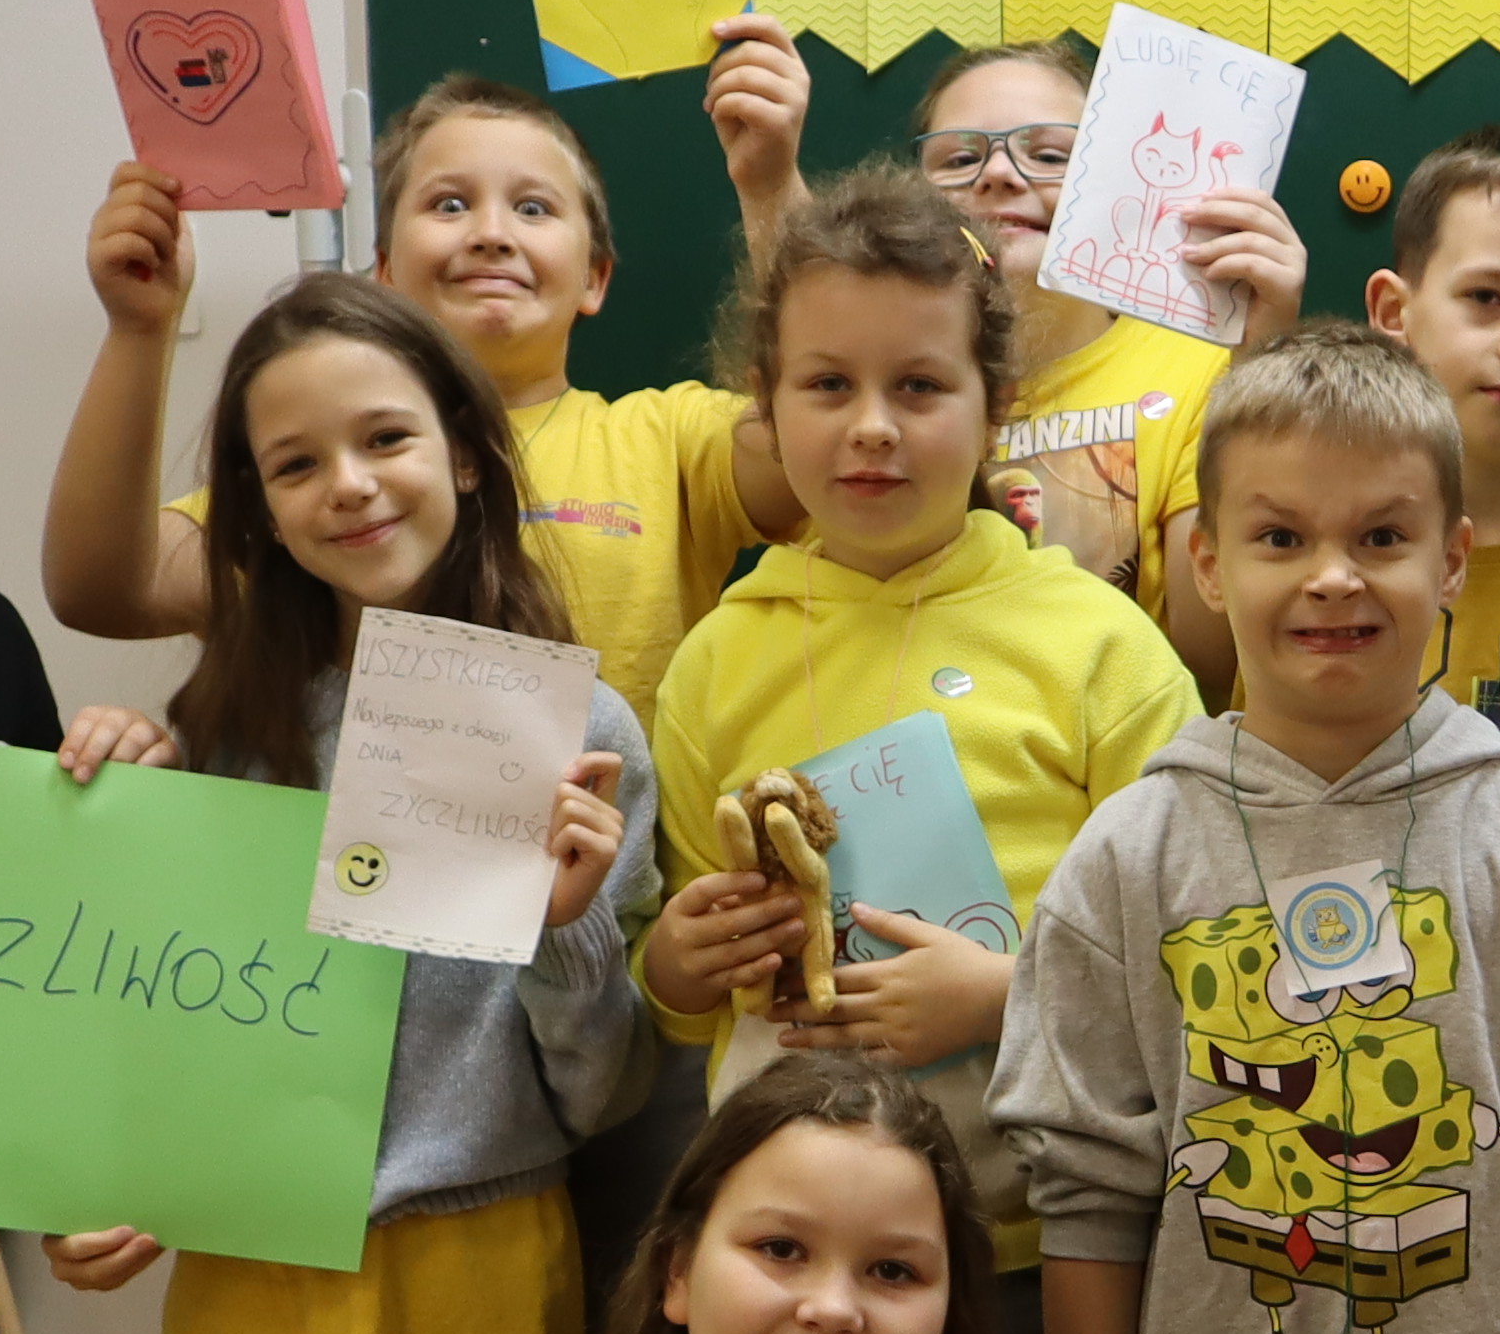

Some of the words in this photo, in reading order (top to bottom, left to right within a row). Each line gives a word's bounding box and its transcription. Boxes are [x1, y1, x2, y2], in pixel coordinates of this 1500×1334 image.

[352, 697, 445, 734] Najlepszego
[451, 723, 459, 733] z
[465, 718, 512, 746] okazji
[378, 790, 549, 847] ZYCZLIWOŚC
